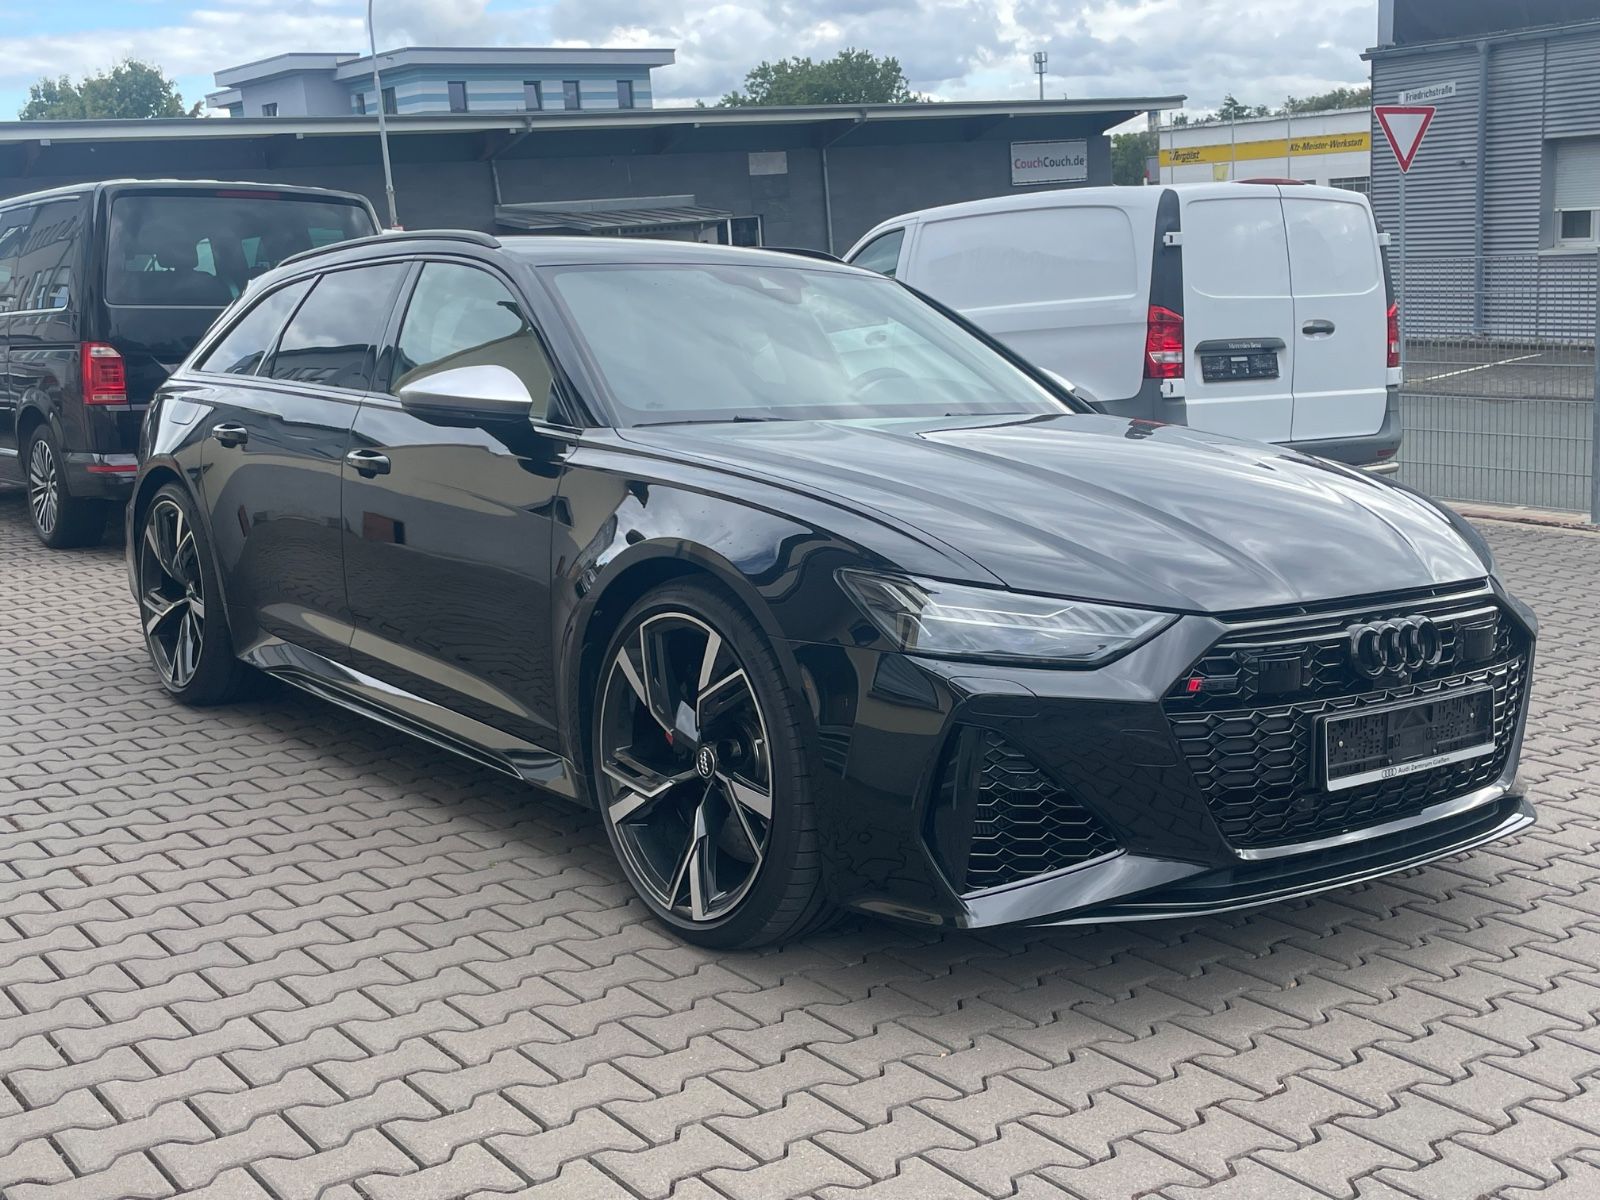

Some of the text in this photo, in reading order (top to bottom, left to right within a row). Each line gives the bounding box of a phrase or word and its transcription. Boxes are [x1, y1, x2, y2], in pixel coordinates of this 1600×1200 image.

[1405, 84, 1453, 102] Friedrichstraße
[1290, 138, 1364, 152] Kfz-Meister-Werkstatt
[1014, 155, 1085, 170] CouchCouch.de
[1411, 761, 1433, 771] Zentrum
